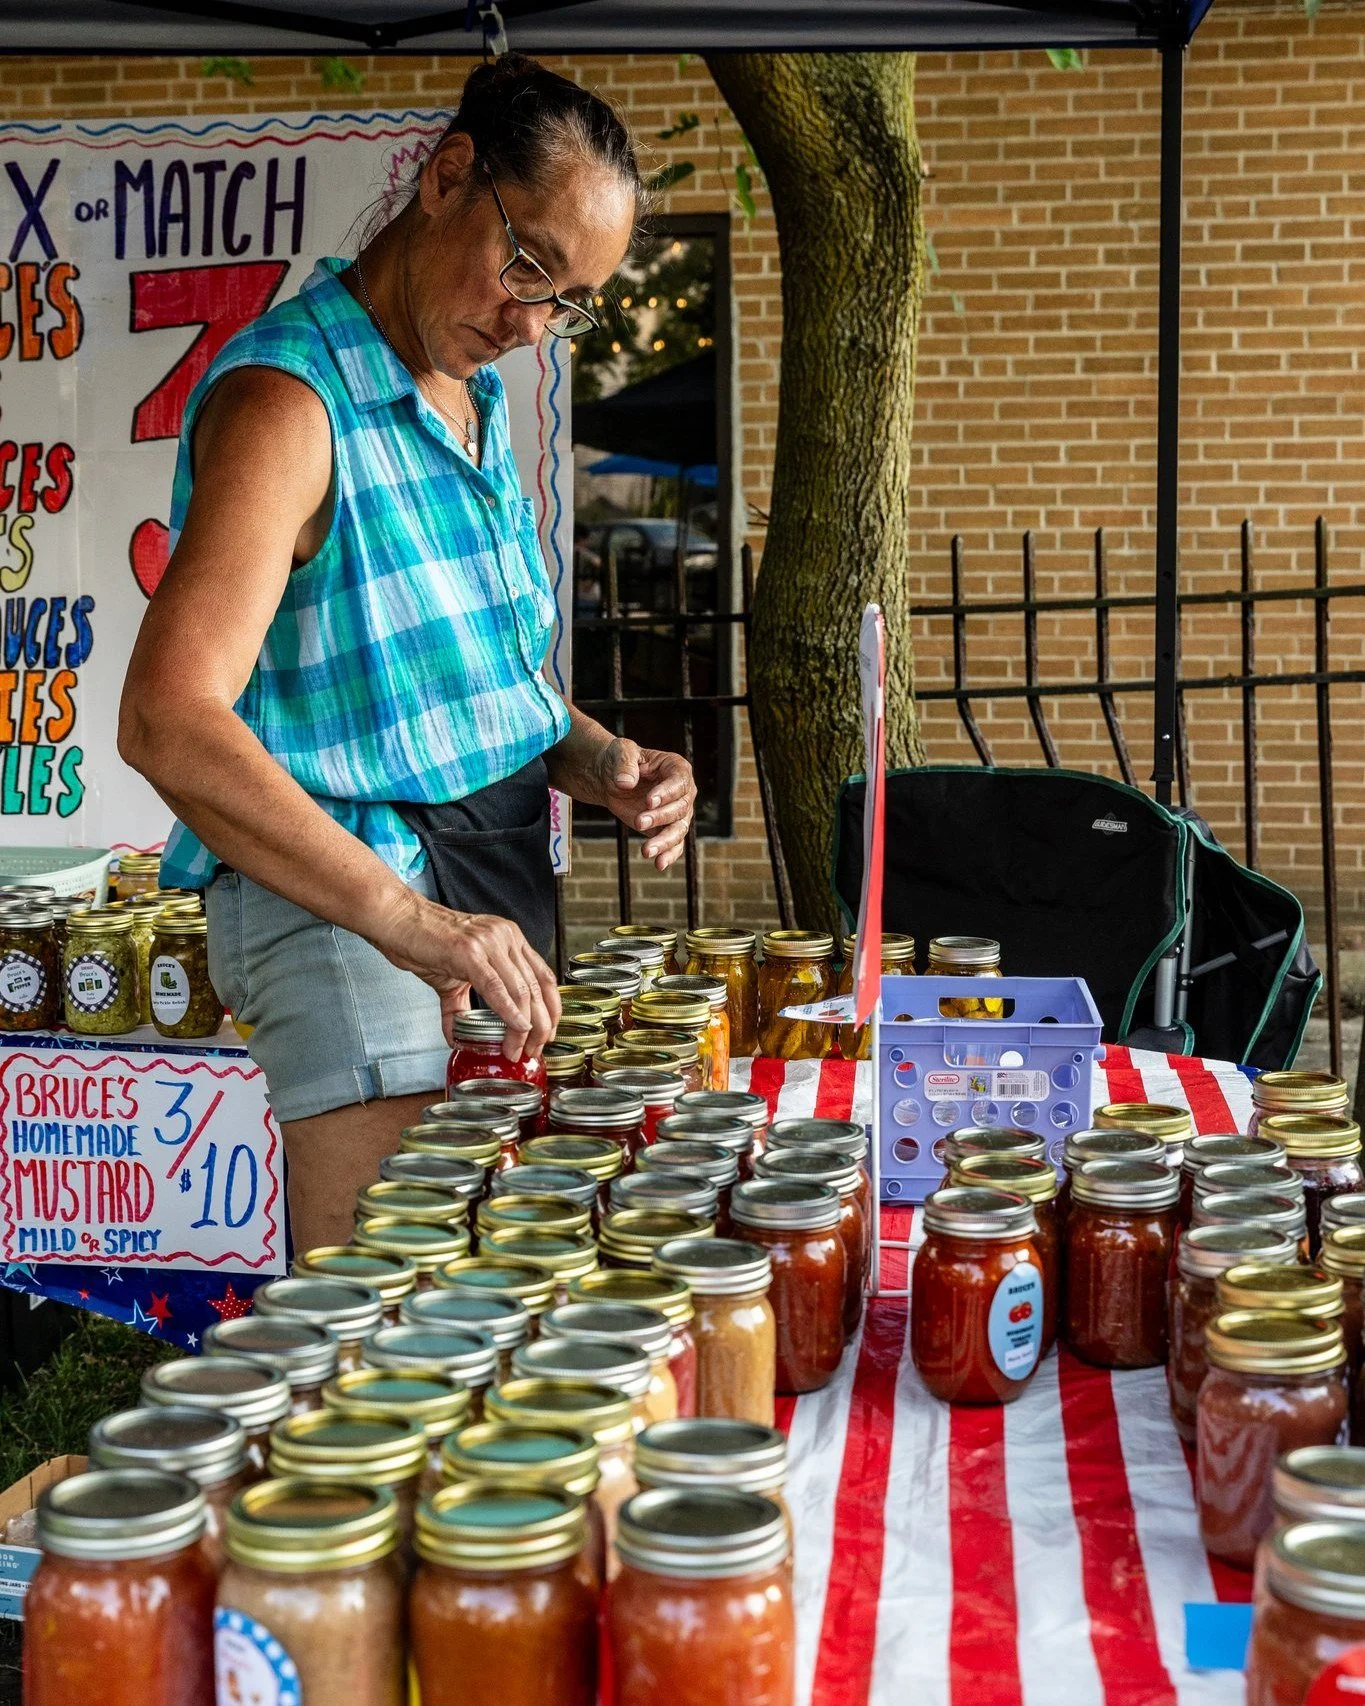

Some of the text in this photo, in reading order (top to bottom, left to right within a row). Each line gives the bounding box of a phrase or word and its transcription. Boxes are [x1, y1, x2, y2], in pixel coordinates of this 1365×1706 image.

[74, 198, 110, 222] OR
[114, 156, 306, 260] MATCH
[15, 1073, 139, 1120] BRUCE'S
[12, 1121, 142, 1157] HOMEMADE
[13, 1159, 155, 1224] MUSTARD
[18, 1227, 163, 1254] MILD OR SPICY
